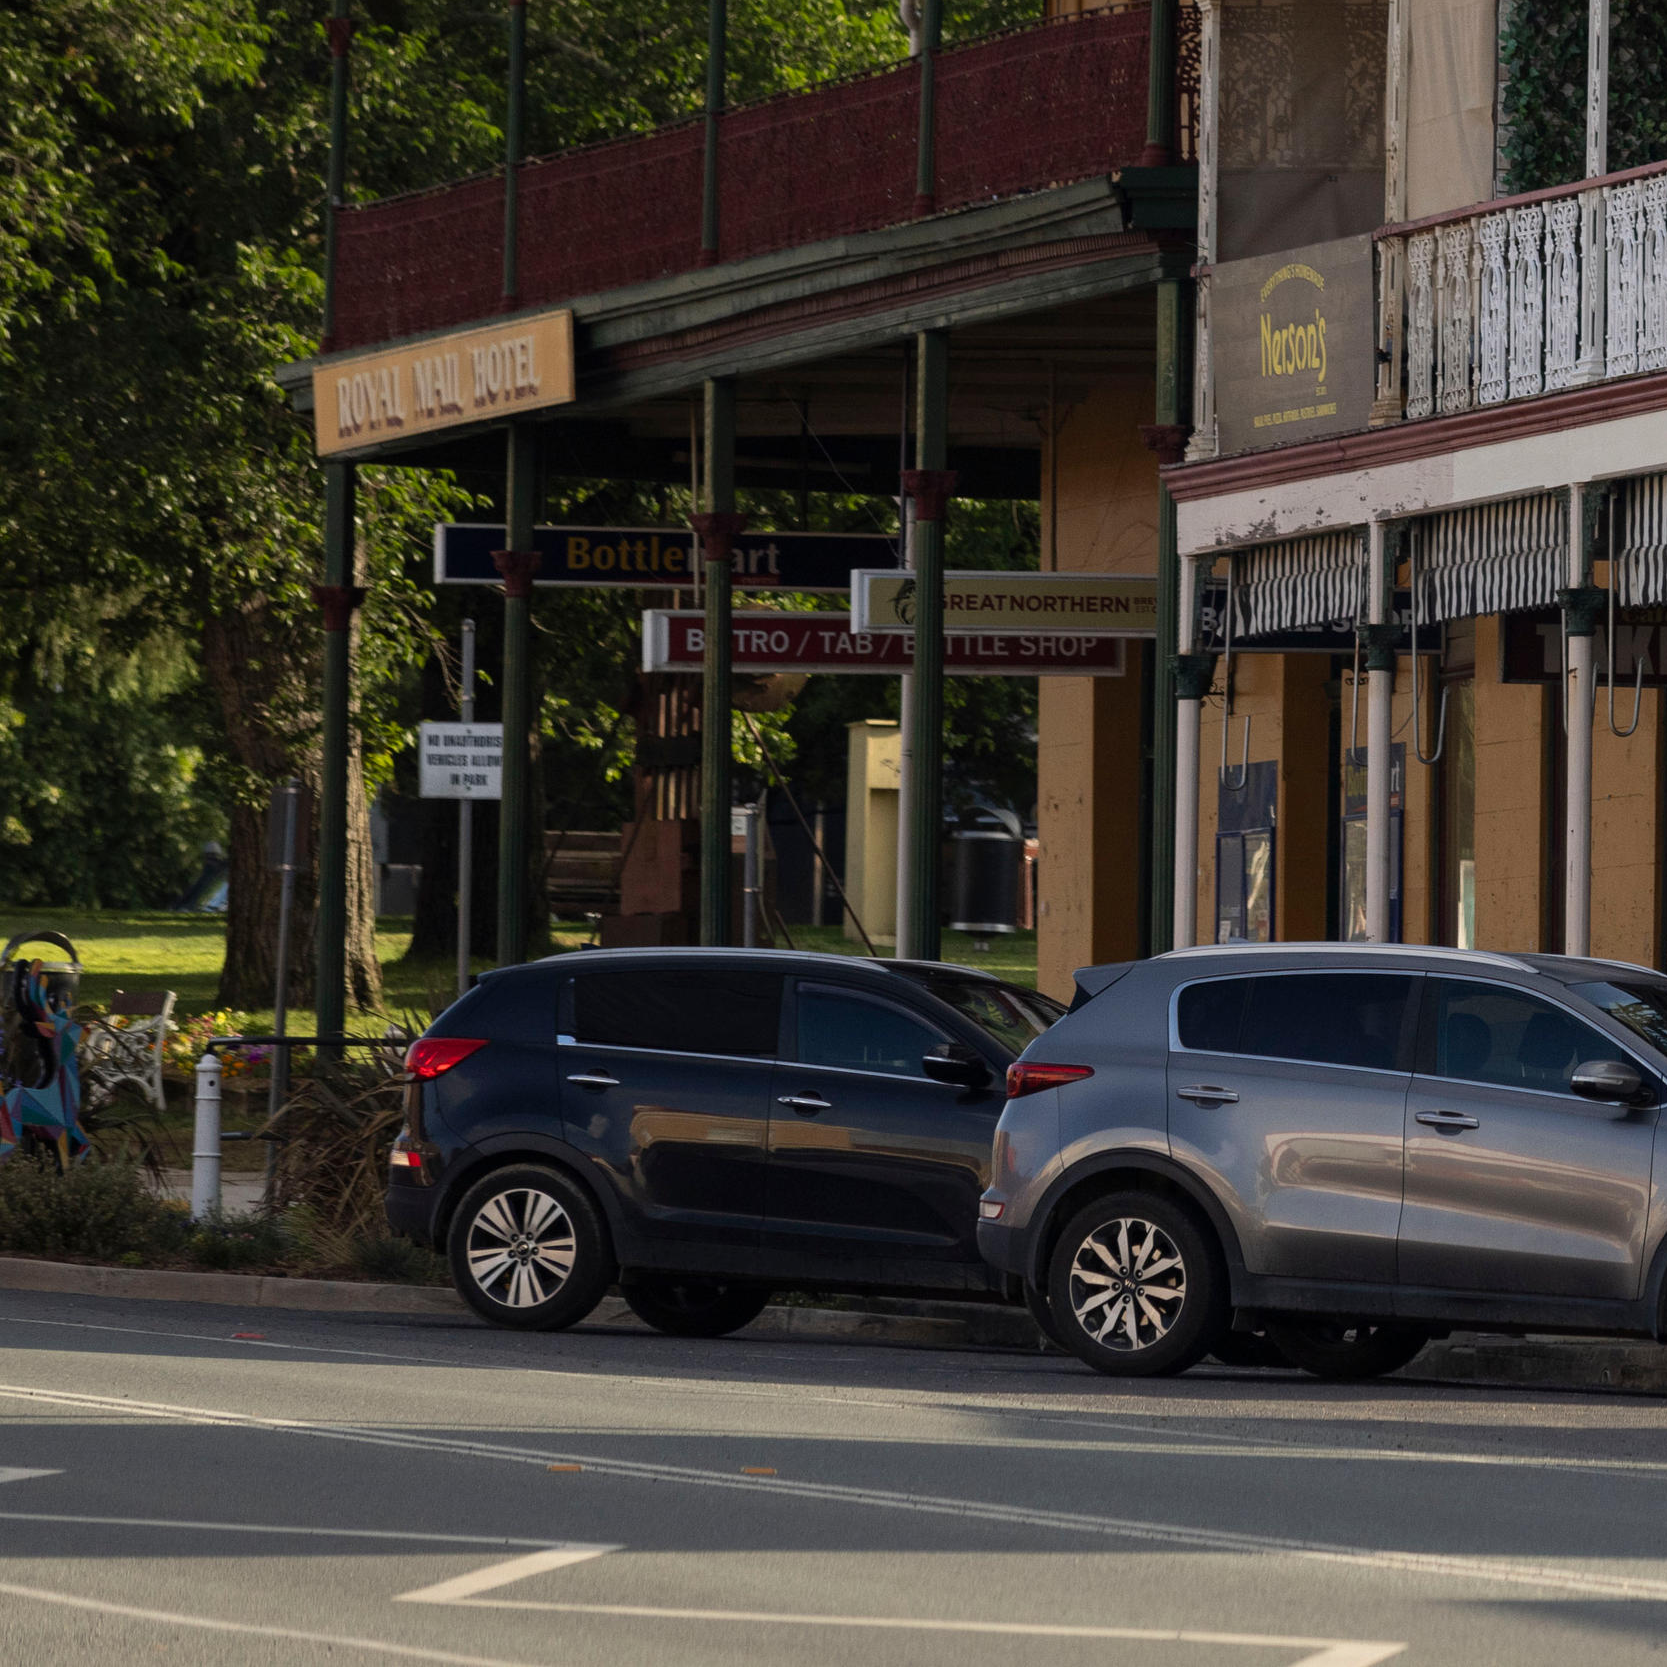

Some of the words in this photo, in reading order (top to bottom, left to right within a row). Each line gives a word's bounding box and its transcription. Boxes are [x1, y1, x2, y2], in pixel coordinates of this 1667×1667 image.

[1260, 308, 1327, 383] Nerson's
[336, 365, 407, 435] ROYAL
[413, 352, 464, 416] MAIL
[471, 335, 541, 405] HOTEL
[566, 536, 781, 575] Bottleart
[1010, 595, 1130, 613] NORTHERN
[685, 628, 790, 653] BTRO
[817, 630, 874, 654] TAB
[902, 634, 1009, 656] BTTLE
[1019, 635, 1098, 656] SHOP
[427, 734, 440, 747] NO
[443, 734, 502, 747] UNAUTHORIS
[426, 753, 468, 766] VEHICLES
[450, 773, 460, 785] IN
[463, 773, 488, 785] PARK
